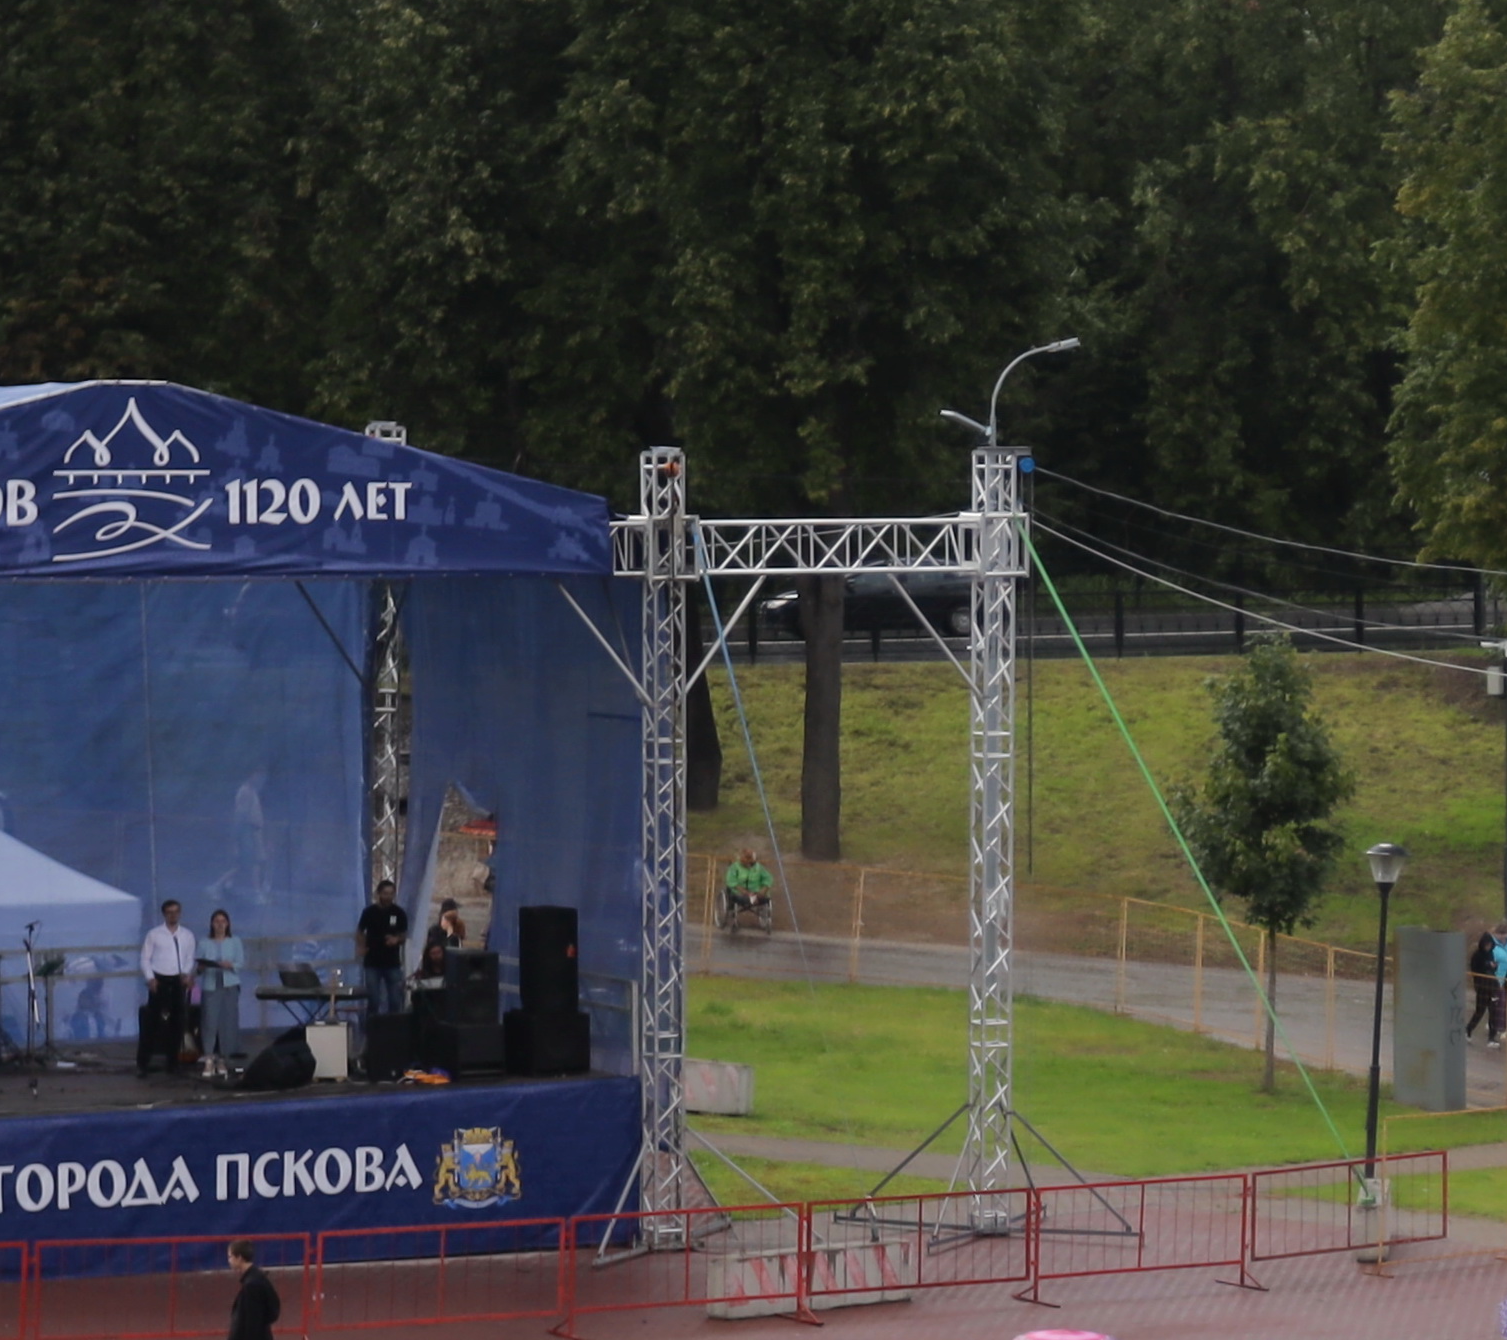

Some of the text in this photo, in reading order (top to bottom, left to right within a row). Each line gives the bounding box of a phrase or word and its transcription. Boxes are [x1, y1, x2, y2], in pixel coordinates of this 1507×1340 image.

[224, 477, 321, 525] 1120
[333, 480, 413, 522] ЛЕТ
[215, 1143, 423, 1201] ПСКОВА
